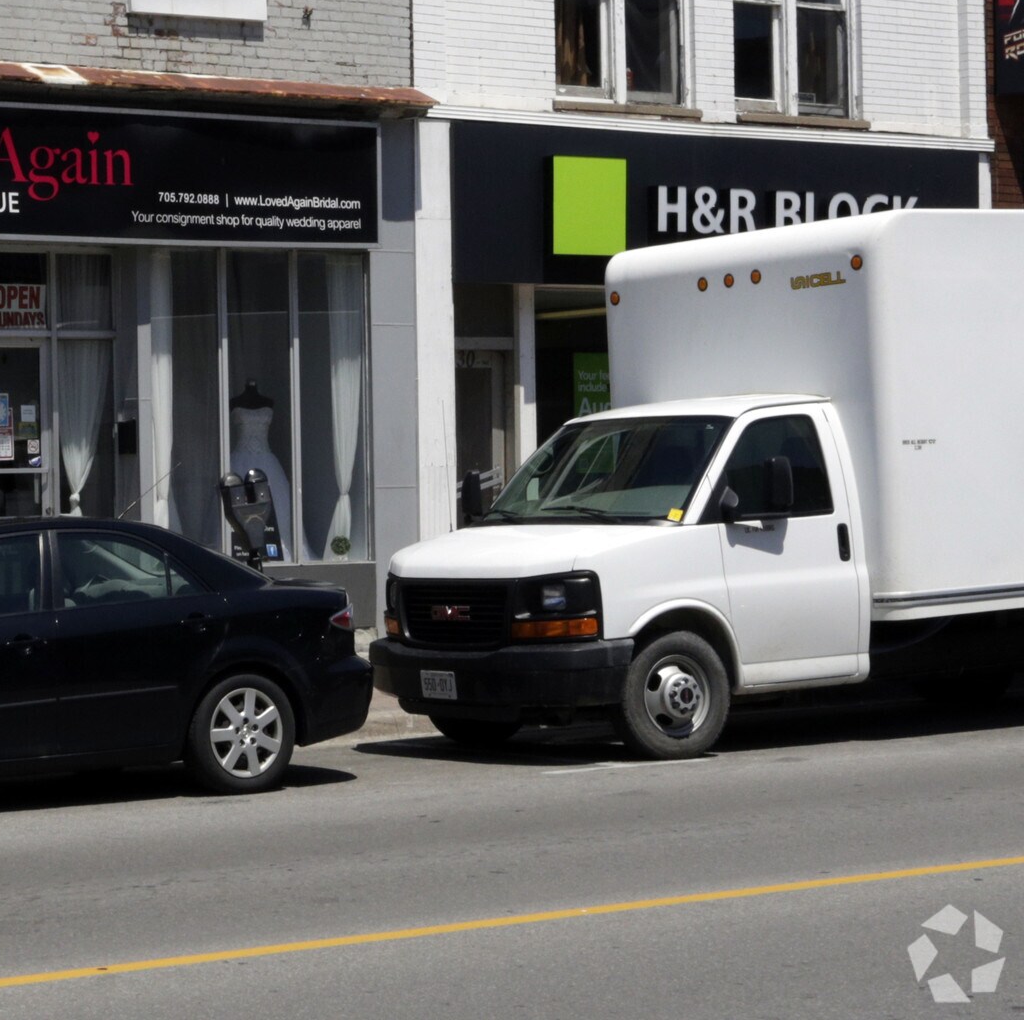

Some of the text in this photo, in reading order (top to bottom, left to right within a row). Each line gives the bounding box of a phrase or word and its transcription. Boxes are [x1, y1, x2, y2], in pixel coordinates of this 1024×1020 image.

[158, 192, 220, 205] 705.792.0888
[234, 194, 361, 210] www.LovedAgainBridal.com
[657, 185, 918, 234] H&R BLO
[131, 210, 362, 231] Your consignment shop for quality wedding apparel
